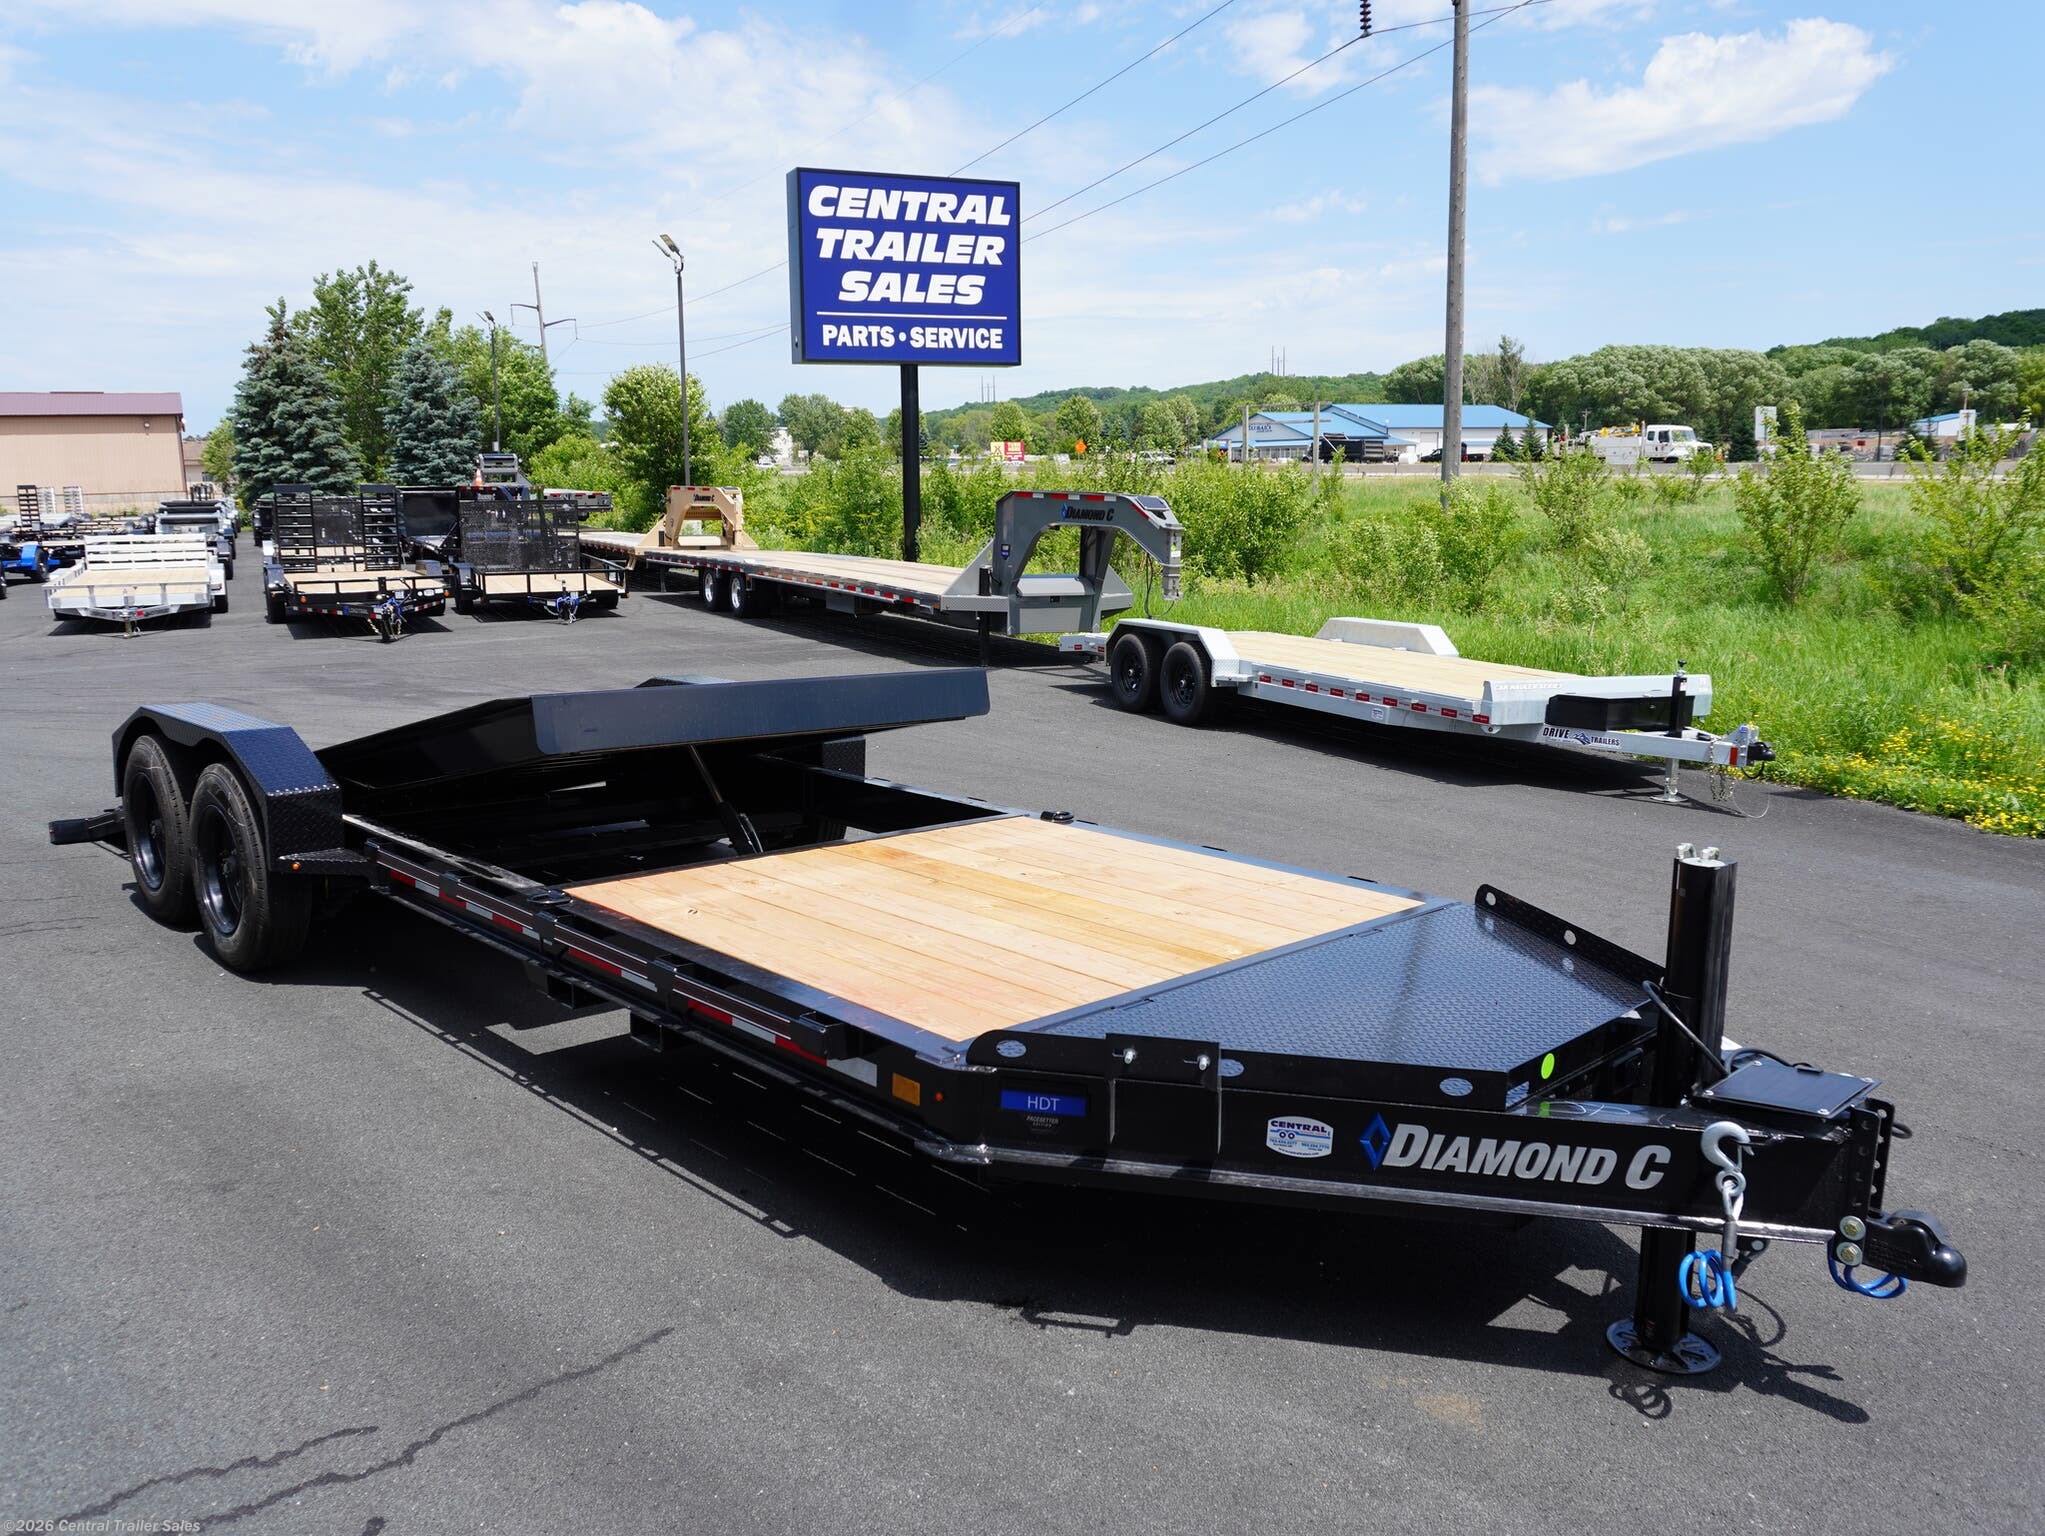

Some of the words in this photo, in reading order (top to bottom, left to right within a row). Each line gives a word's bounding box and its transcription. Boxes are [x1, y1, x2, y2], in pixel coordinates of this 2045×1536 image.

[808, 185, 1011, 226] CENTRAL
[816, 227, 1006, 265] TRAILER
[838, 270, 986, 306] SALES
[822, 324, 895, 347] PARTS
[910, 326, 1003, 350] SERVICE
[1066, 506, 1106, 521] DIAMOND
[1106, 508, 1115, 521] C
[1543, 727, 1570, 739] DRIVE
[1590, 736, 1620, 746] TRAILERS
[1027, 1096, 1061, 1111] HDT
[1271, 1120, 1327, 1133] CENTRAL
[1382, 1123, 1617, 1186] DIAMOND
[1625, 1145, 1671, 1190] C
